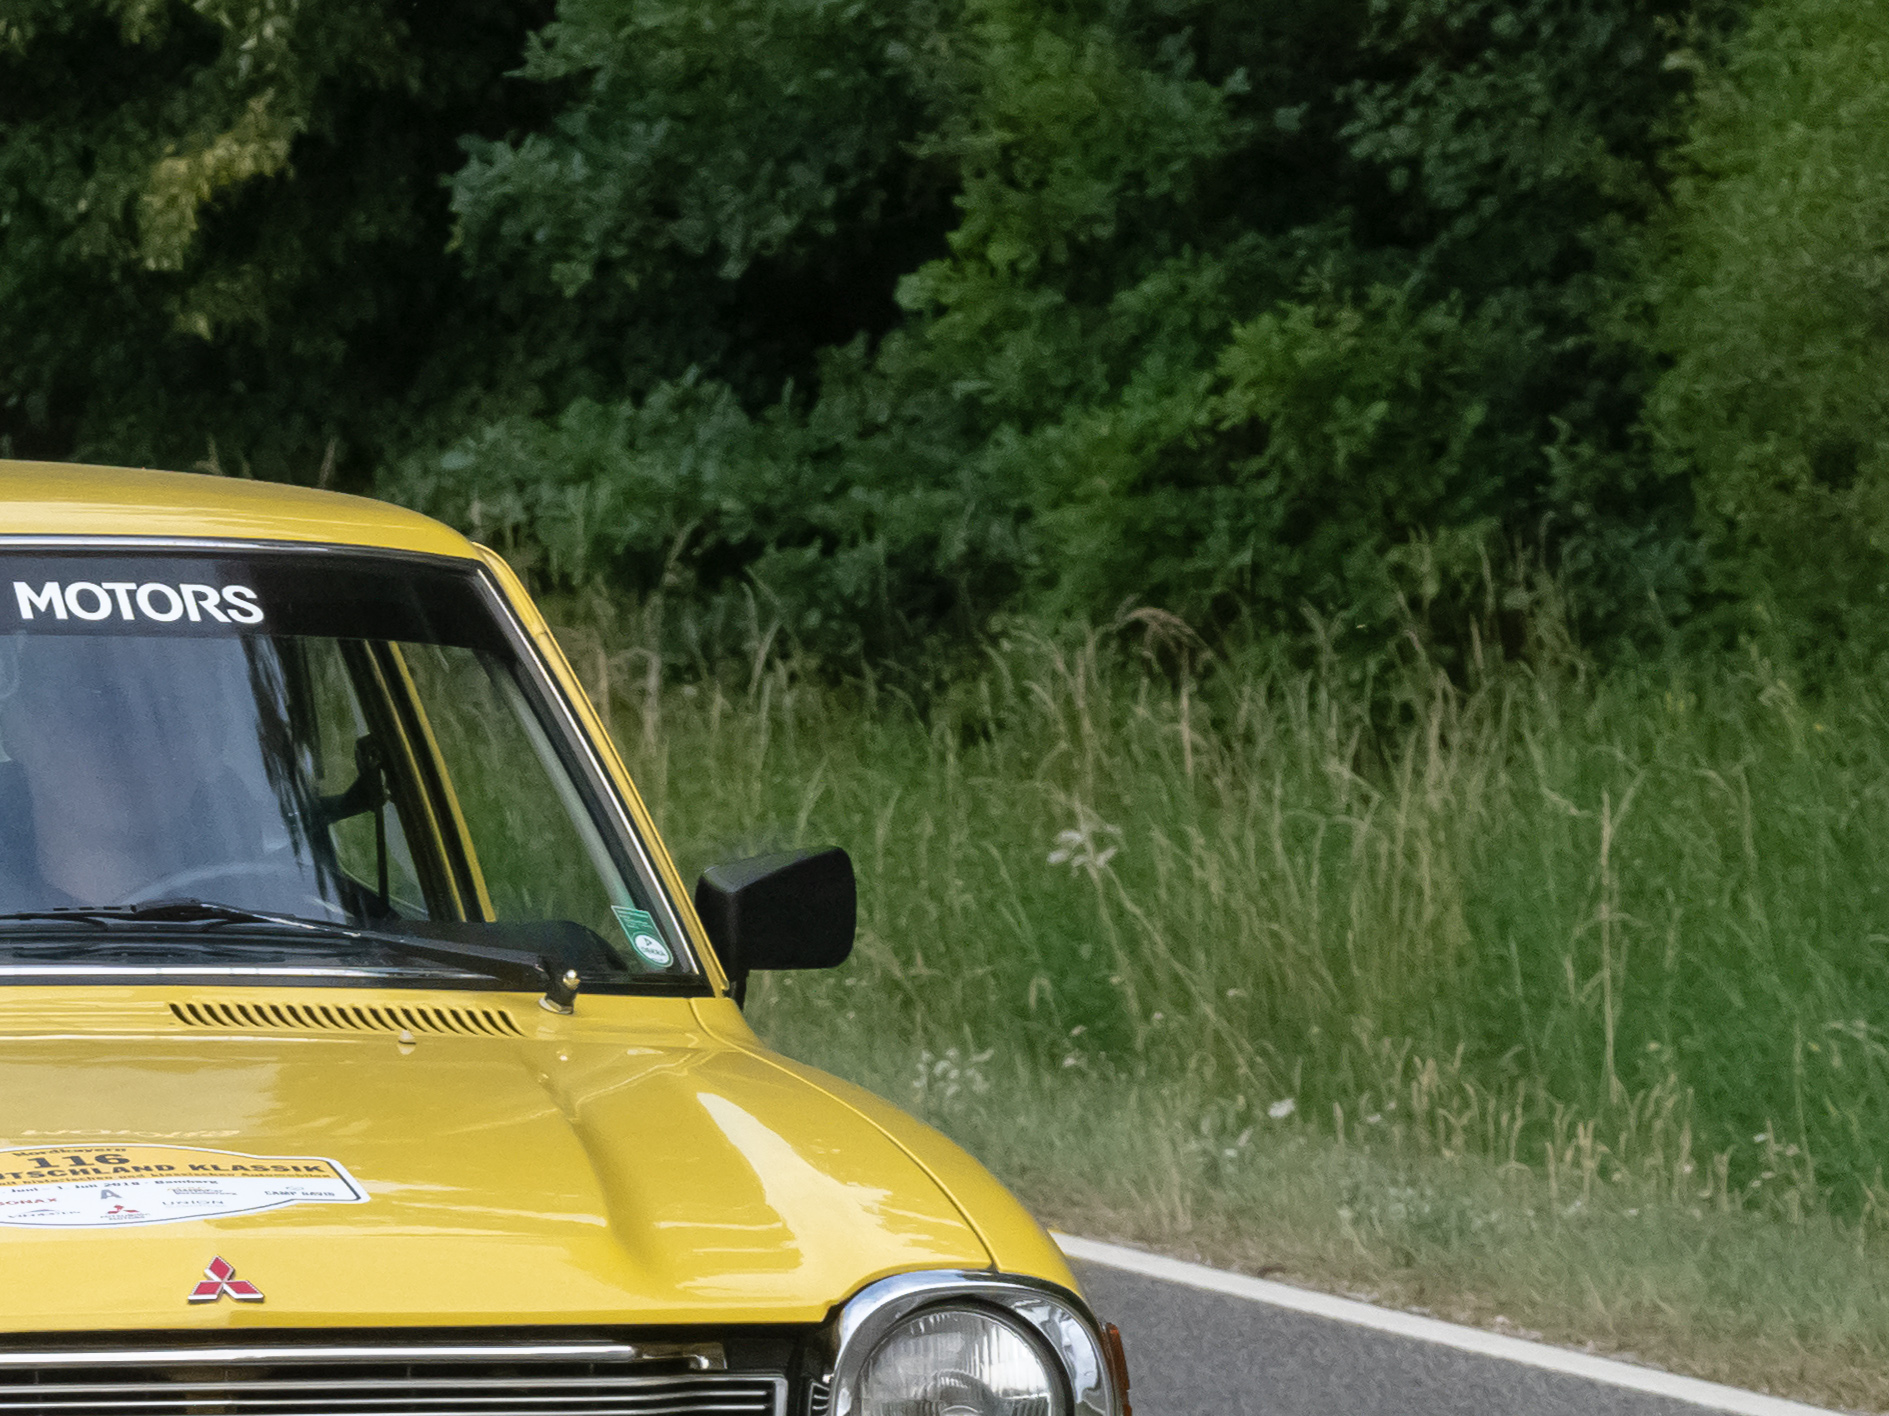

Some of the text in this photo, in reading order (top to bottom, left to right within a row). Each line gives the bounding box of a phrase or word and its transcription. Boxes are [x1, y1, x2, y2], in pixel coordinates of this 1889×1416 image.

[14, 581, 266, 625] MOTORS
[27, 1153, 130, 1169] 116
[188, 1164, 325, 1172] KLASSIK
